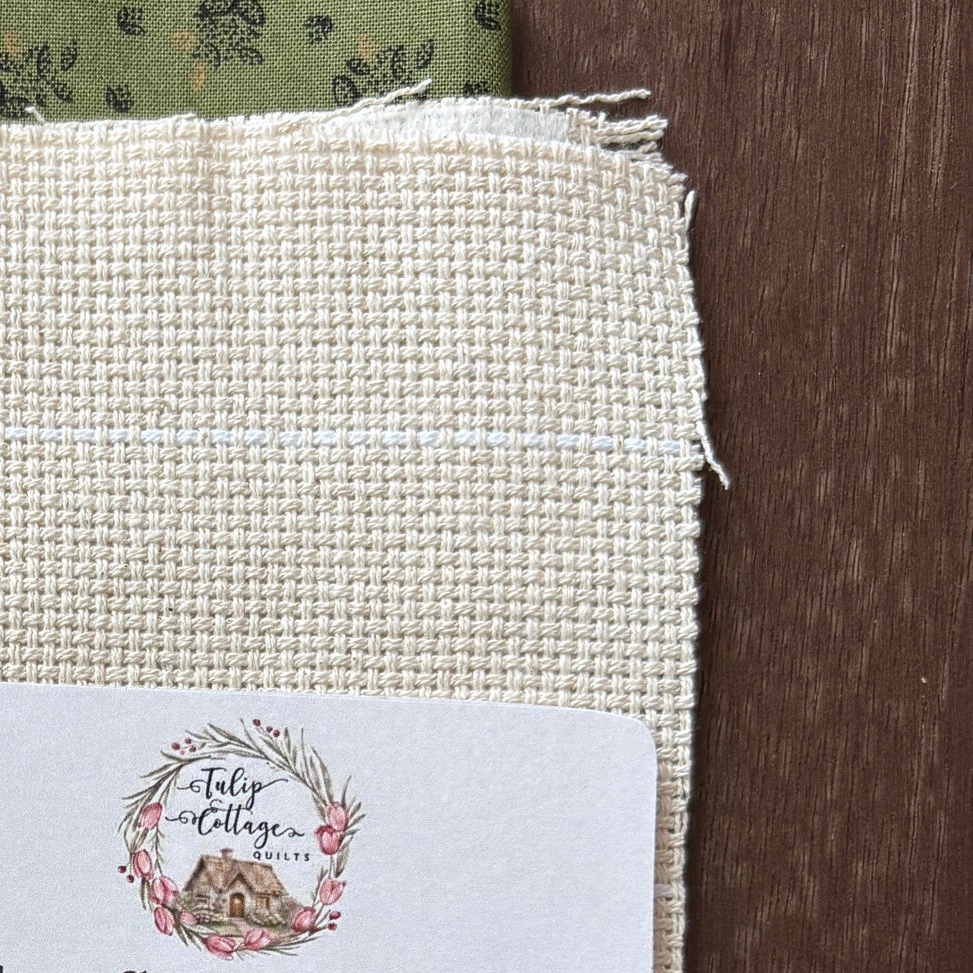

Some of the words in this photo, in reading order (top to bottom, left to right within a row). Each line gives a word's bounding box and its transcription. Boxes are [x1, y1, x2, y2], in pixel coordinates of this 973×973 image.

[176, 767, 289, 810] Tulip
[165, 799, 305, 849] Cottage
[253, 851, 311, 862] QUILTS
